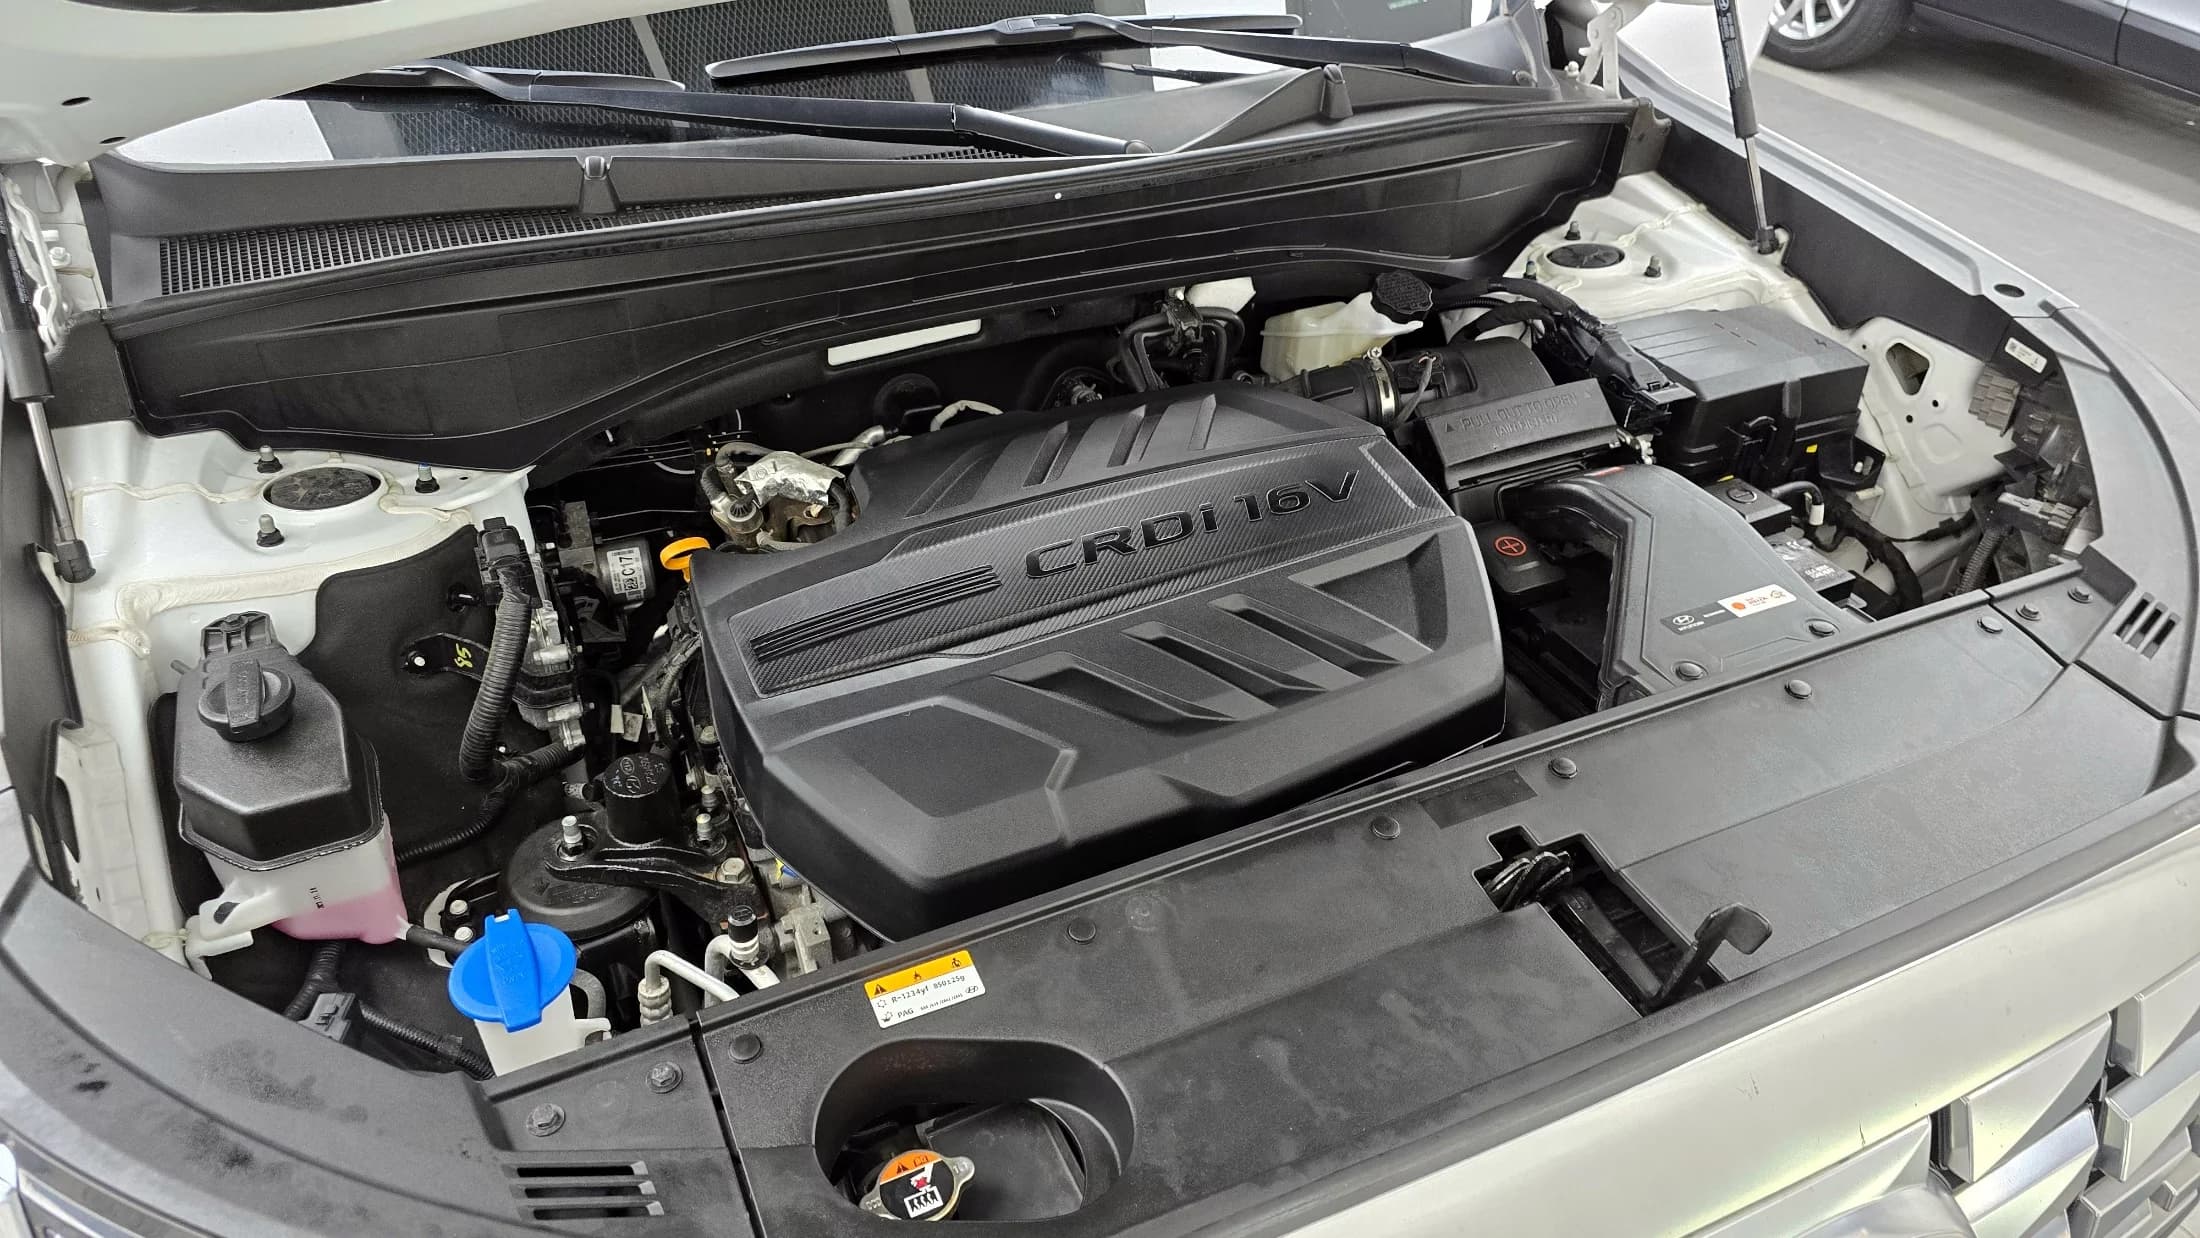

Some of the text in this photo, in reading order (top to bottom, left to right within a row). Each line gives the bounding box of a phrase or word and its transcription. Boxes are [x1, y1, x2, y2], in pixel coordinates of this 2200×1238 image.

[1025, 470, 1360, 578] CRDi 16V
[619, 557, 635, 576] C17
[891, 985, 929, 1003] R-1234yf
[897, 1007, 914, 1018] PAG
